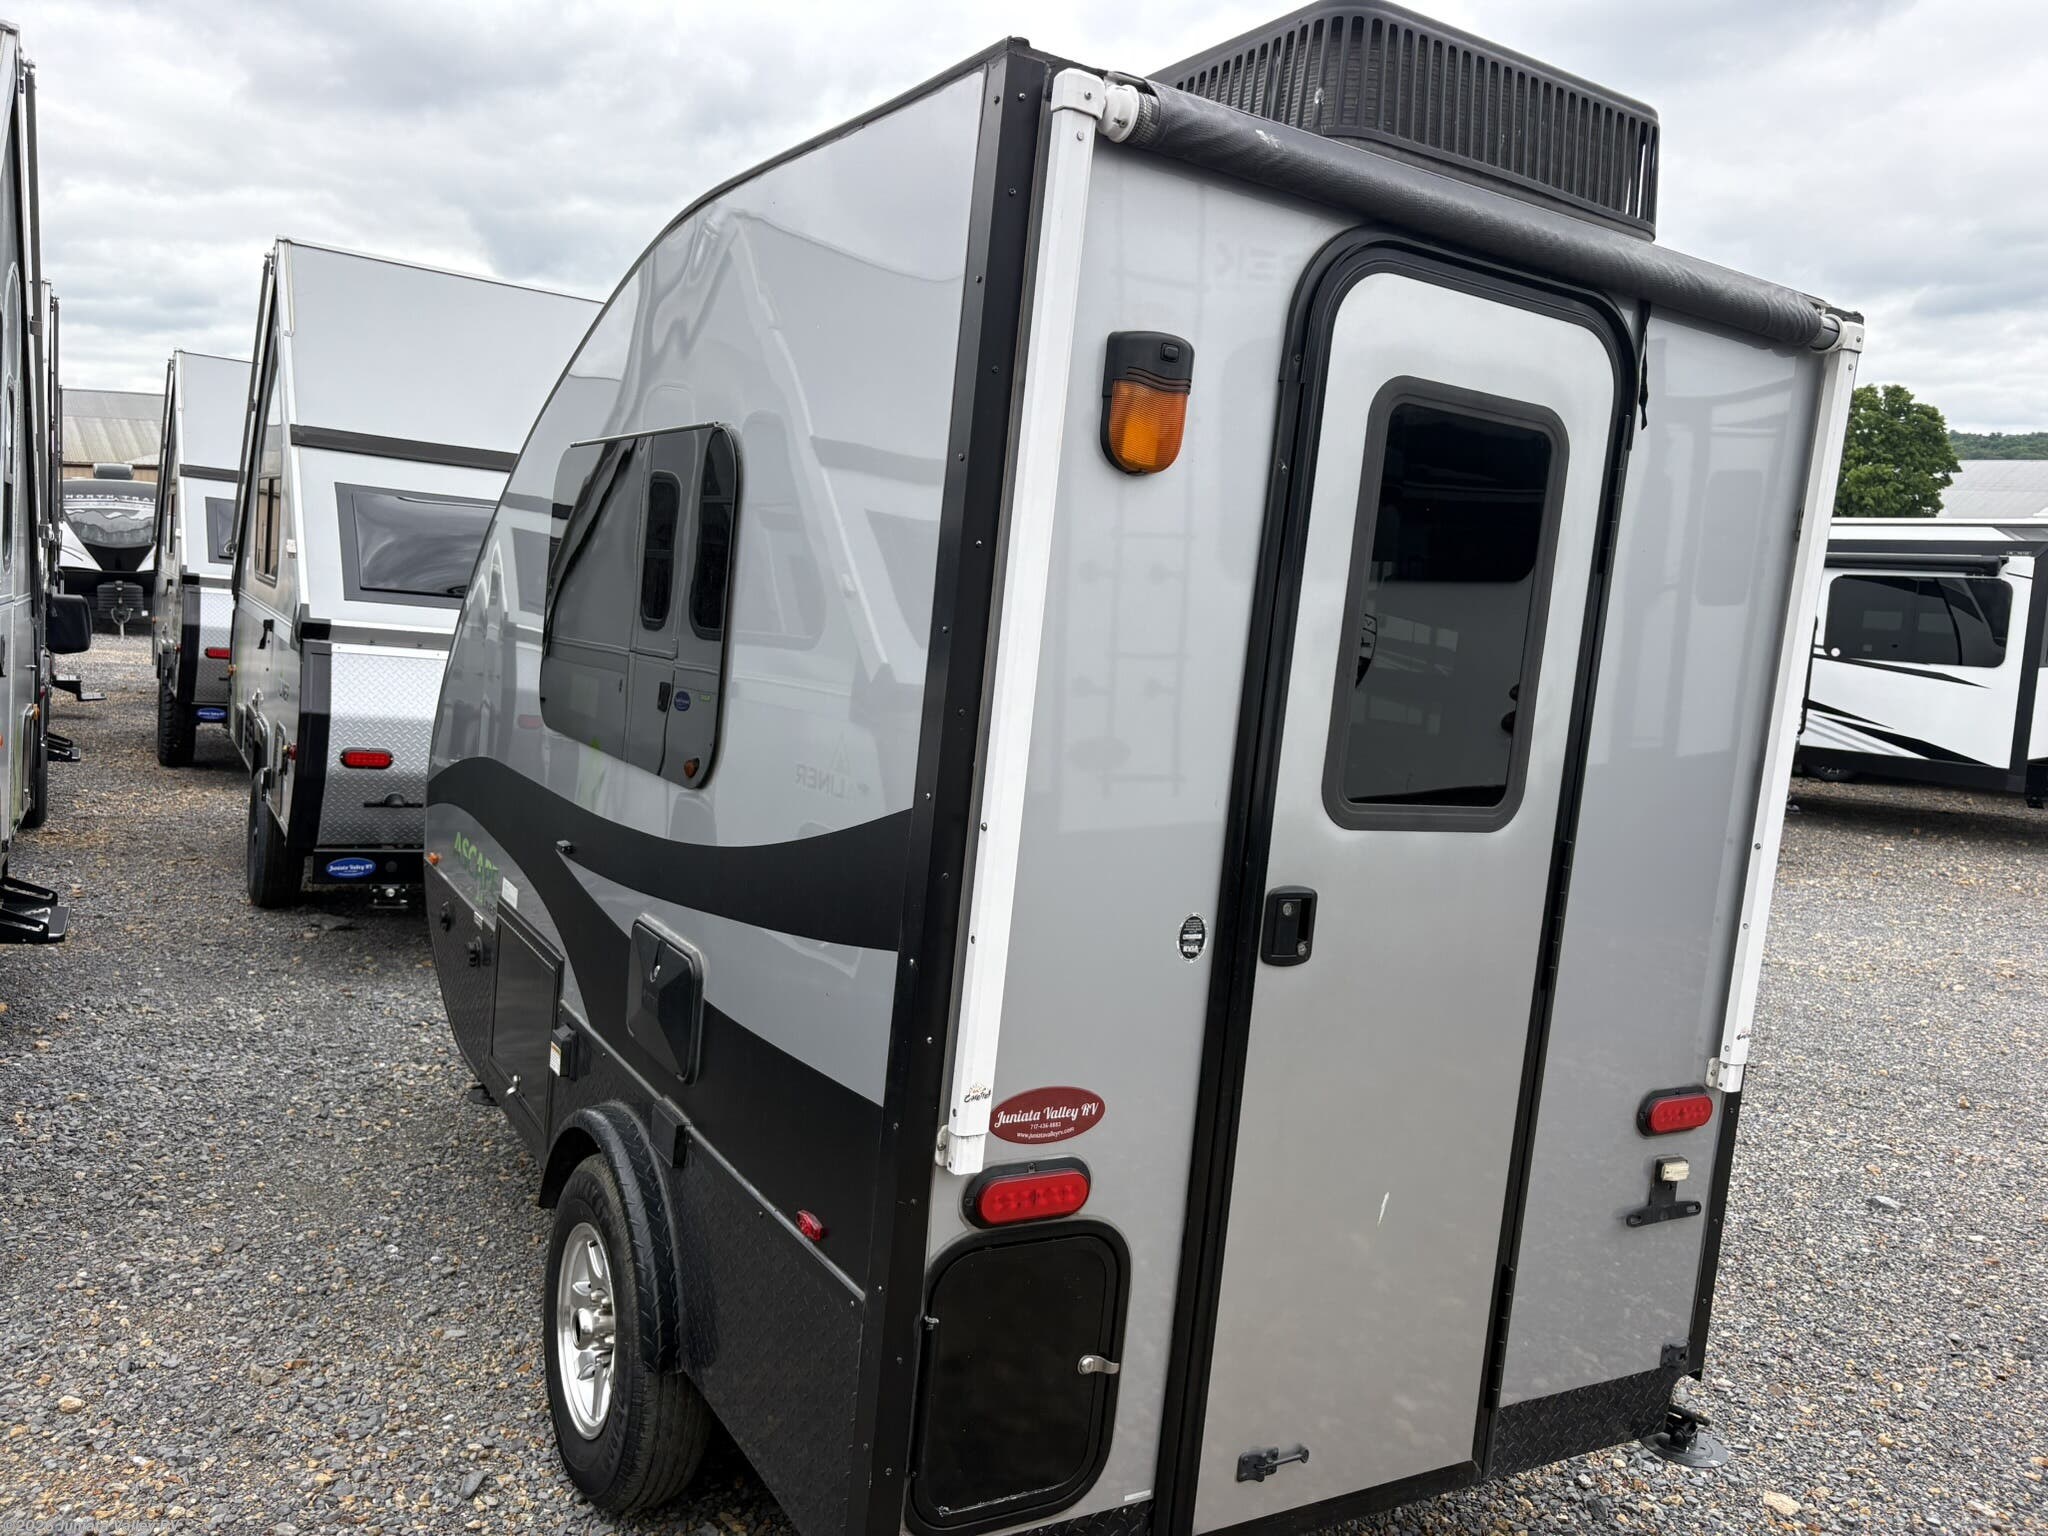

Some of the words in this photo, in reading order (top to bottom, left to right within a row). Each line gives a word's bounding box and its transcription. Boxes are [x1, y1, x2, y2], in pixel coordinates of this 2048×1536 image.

[994, 1110, 1041, 1128] Juniata
[1043, 1106, 1079, 1121] Valley
[1081, 1102, 1099, 1117] RV
